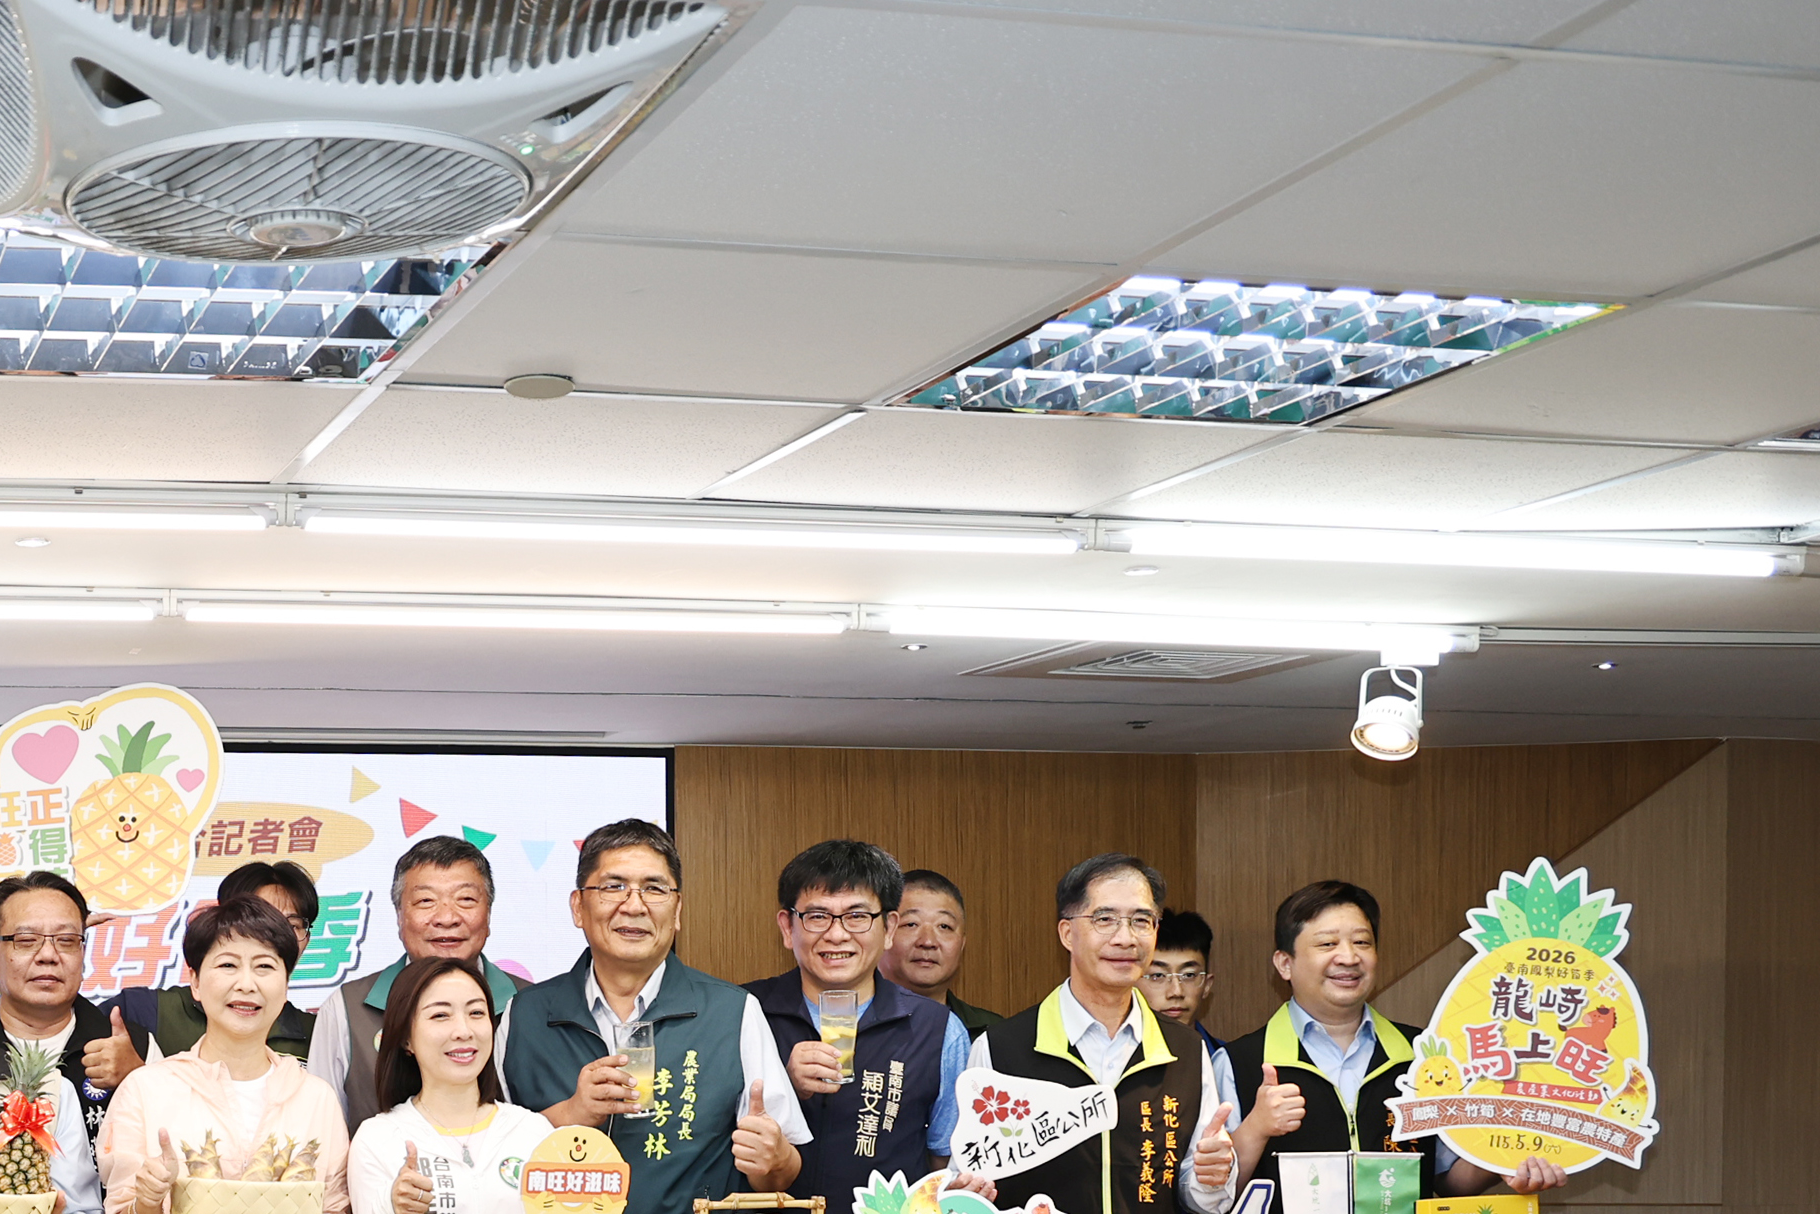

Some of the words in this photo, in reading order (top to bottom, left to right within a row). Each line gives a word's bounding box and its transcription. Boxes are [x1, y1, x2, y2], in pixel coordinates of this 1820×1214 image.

[194, 816, 324, 857] 記者會
[1526, 947, 1576, 964] 2026
[1492, 975, 1585, 1023] 龍崎
[1463, 1023, 1611, 1084] 馬上旺
[643, 1067, 674, 1160] 李芳林
[677, 1049, 700, 1140] 農業局局長
[854, 1069, 885, 1158] 穎艾達利
[882, 1060, 905, 1133] 臺南市議員
[1140, 1100, 1154, 1133] 區長
[960, 1090, 1109, 1172] 新化區公所
[1162, 1094, 1179, 1189] 新化區公所
[527, 1169, 623, 1194] 南旺好滋味
[1139, 1138, 1157, 1204] 李義隆
